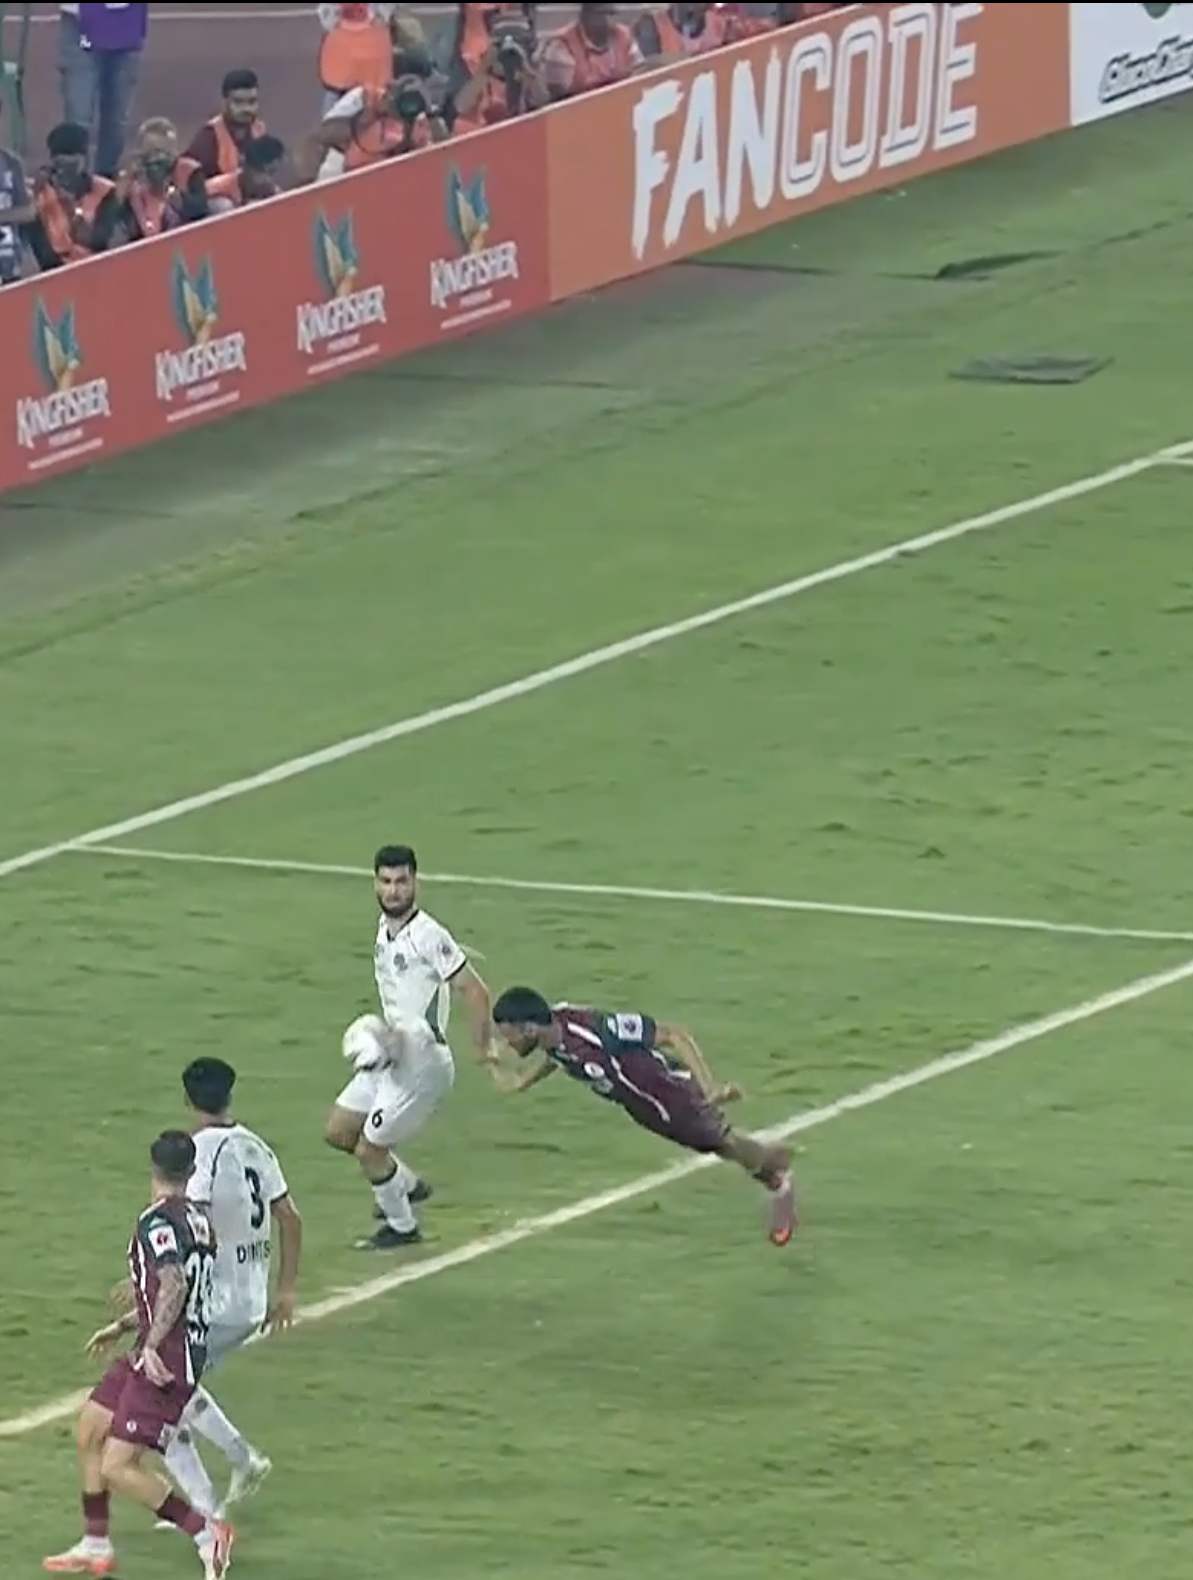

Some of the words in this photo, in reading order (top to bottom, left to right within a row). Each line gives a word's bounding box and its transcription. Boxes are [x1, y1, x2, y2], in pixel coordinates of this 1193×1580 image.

[631, 3, 984, 260] FANCODE
[429, 240, 519, 309] KINGFISHER
[296, 284, 387, 354] KINGFISHER
[156, 331, 247, 401] KINGFISHER
[16, 377, 111, 449] KINGFISHER
[371, 1108, 384, 1129] 6
[244, 1166, 266, 1230] 3
